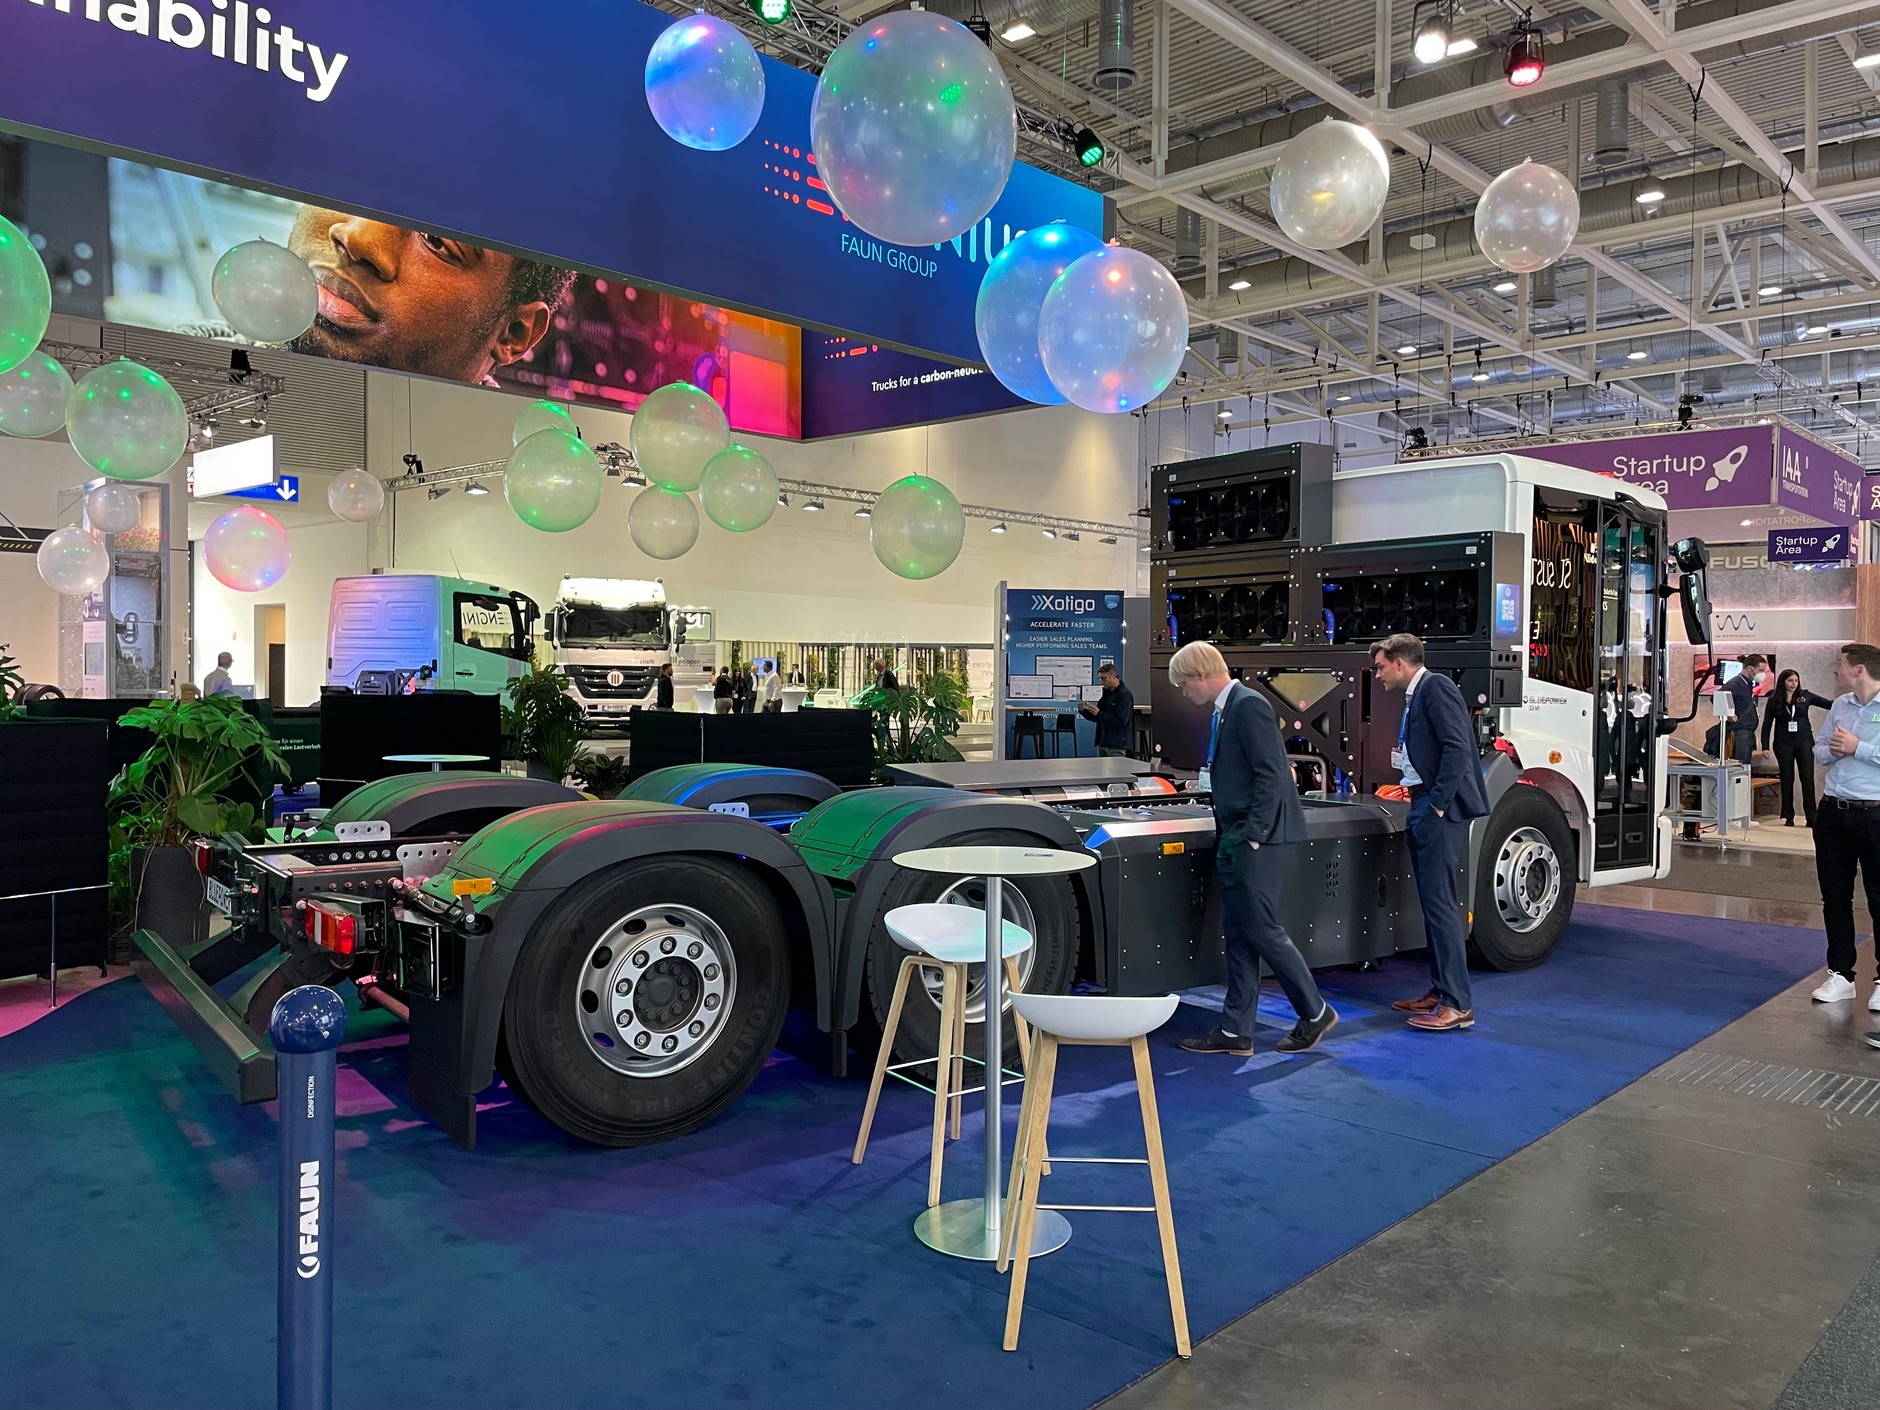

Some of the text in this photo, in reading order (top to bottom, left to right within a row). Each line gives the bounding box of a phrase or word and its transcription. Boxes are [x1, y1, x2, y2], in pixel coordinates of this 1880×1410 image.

[841, 233, 938, 278] FAUN GROUP
[872, 367, 984, 392] Trucks for a carbon-neu
[1613, 454, 1706, 477] Startup
[1782, 445, 1801, 484] IAA
[1833, 470, 1853, 500] Startup
[1833, 490, 1846, 513] Area
[1775, 545, 1802, 555] Area
[1776, 536, 1818, 547] Startup
[1041, 595, 1096, 615] Xotigo
[1071, 621, 1095, 629] FASTER
[679, 658, 701, 666] pepper
[307, 1075, 315, 1119] DISINFECTION
[299, 1160, 320, 1255] FAUN
